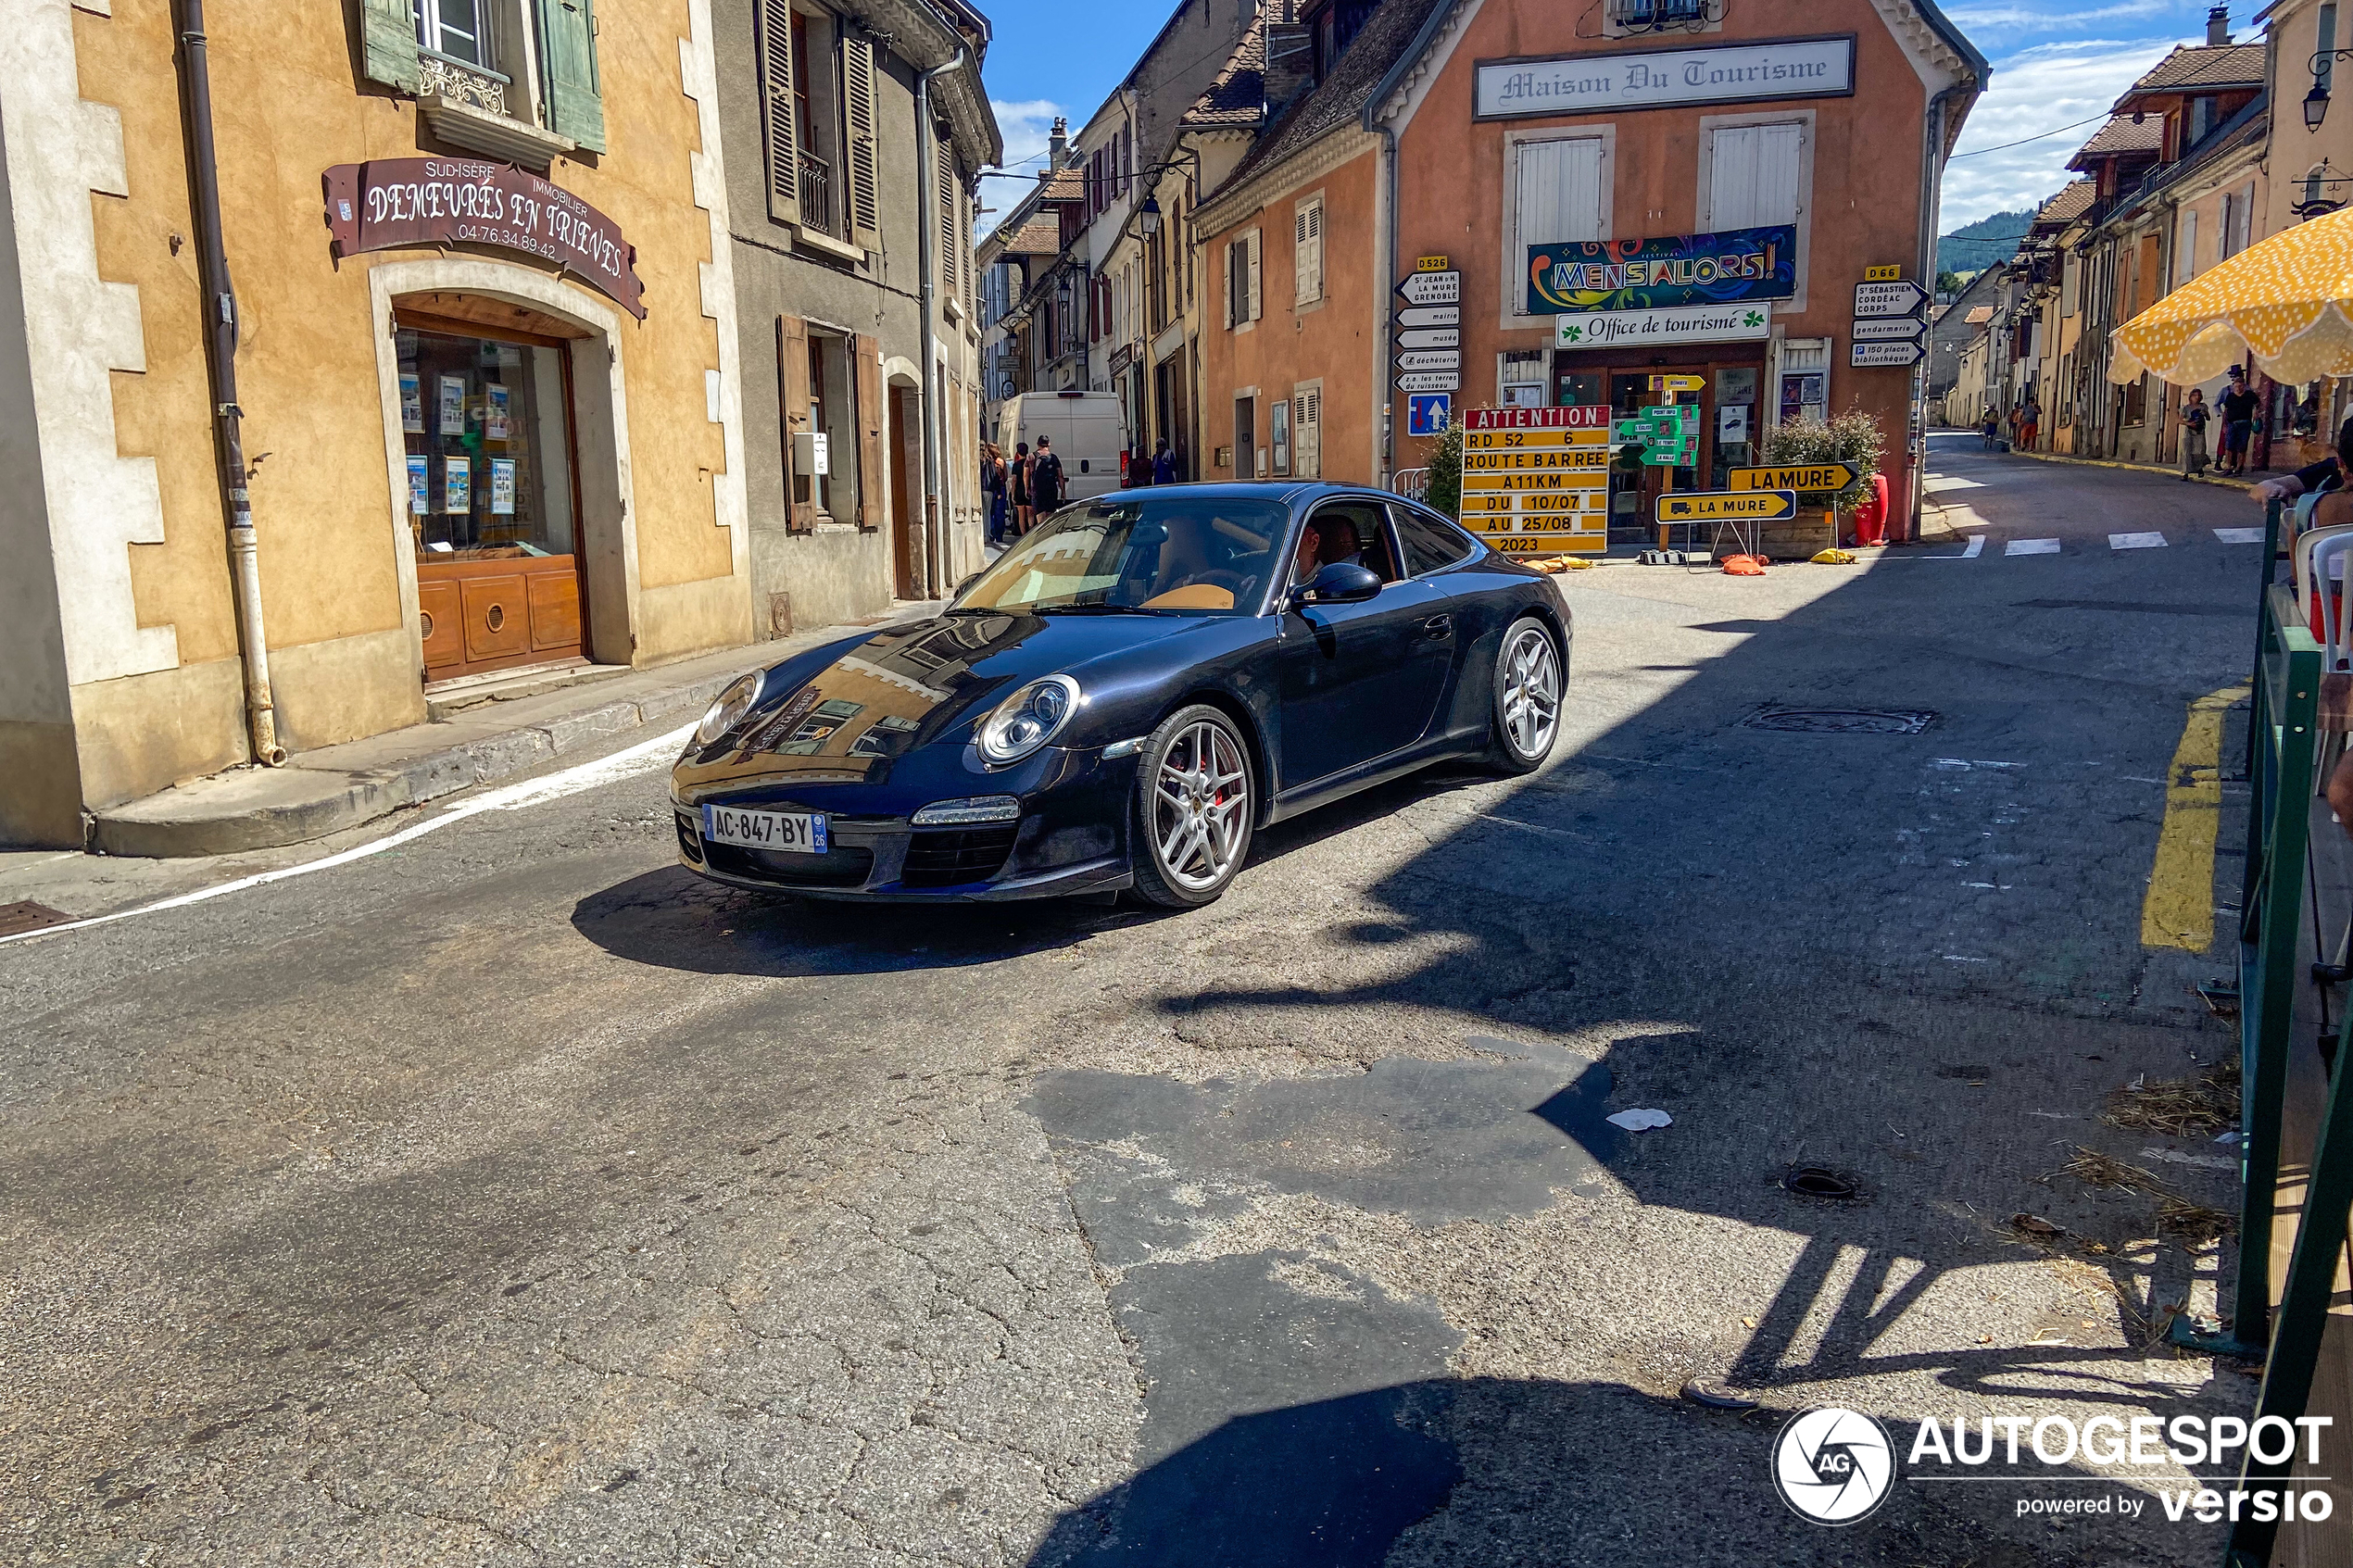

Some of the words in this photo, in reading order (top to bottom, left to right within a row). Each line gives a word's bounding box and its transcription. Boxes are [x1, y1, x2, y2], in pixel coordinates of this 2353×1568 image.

[1497, 71, 1612, 107] Maison
[1621, 63, 1668, 99] Du
[1681, 57, 1828, 87] Tourisme
[533, 178, 588, 219] IMMOBILIER
[510, 193, 541, 234] EN
[1419, 259, 1425, 269] D
[1427, 258, 1446, 268] 526
[1424, 275, 1443, 283] JEAN
[1869, 269, 1877, 278] D
[1880, 268, 1895, 278] 66
[1432, 283, 1457, 292] MURE
[1869, 284, 1912, 295] SÉBASTIEN
[1414, 292, 1457, 301] GRENOBLE
[1858, 295, 1901, 304] CORDÉAC
[1857, 305, 1888, 313] CORPS
[1432, 312, 1457, 320] mairie
[1588, 318, 1636, 342] Office
[1642, 315, 1659, 333] de
[1666, 310, 1737, 332] tourisme
[1856, 325, 1911, 335] gendarmerie
[1868, 345, 1882, 354] 150
[1883, 345, 1909, 355] places
[1416, 356, 1457, 364] déchèterie
[1855, 354, 1909, 364] bibliothèque
[1478, 407, 1597, 428] ATTENTION
[1465, 454, 1524, 469] ROUTE
[1534, 452, 1604, 467] BARREE
[1751, 472, 1775, 490] LA
[1779, 469, 1835, 489] MURE
[1487, 496, 1511, 509] DU
[1530, 495, 1579, 509] 10/07
[1698, 501, 1716, 513] LA
[1723, 499, 1767, 512] MURE
[1487, 518, 1511, 531] AU
[1522, 516, 1571, 531] 25/08
[1500, 538, 1539, 552] 2023
[715, 809, 808, 846] AC-847-BY
[814, 834, 825, 847] 26
